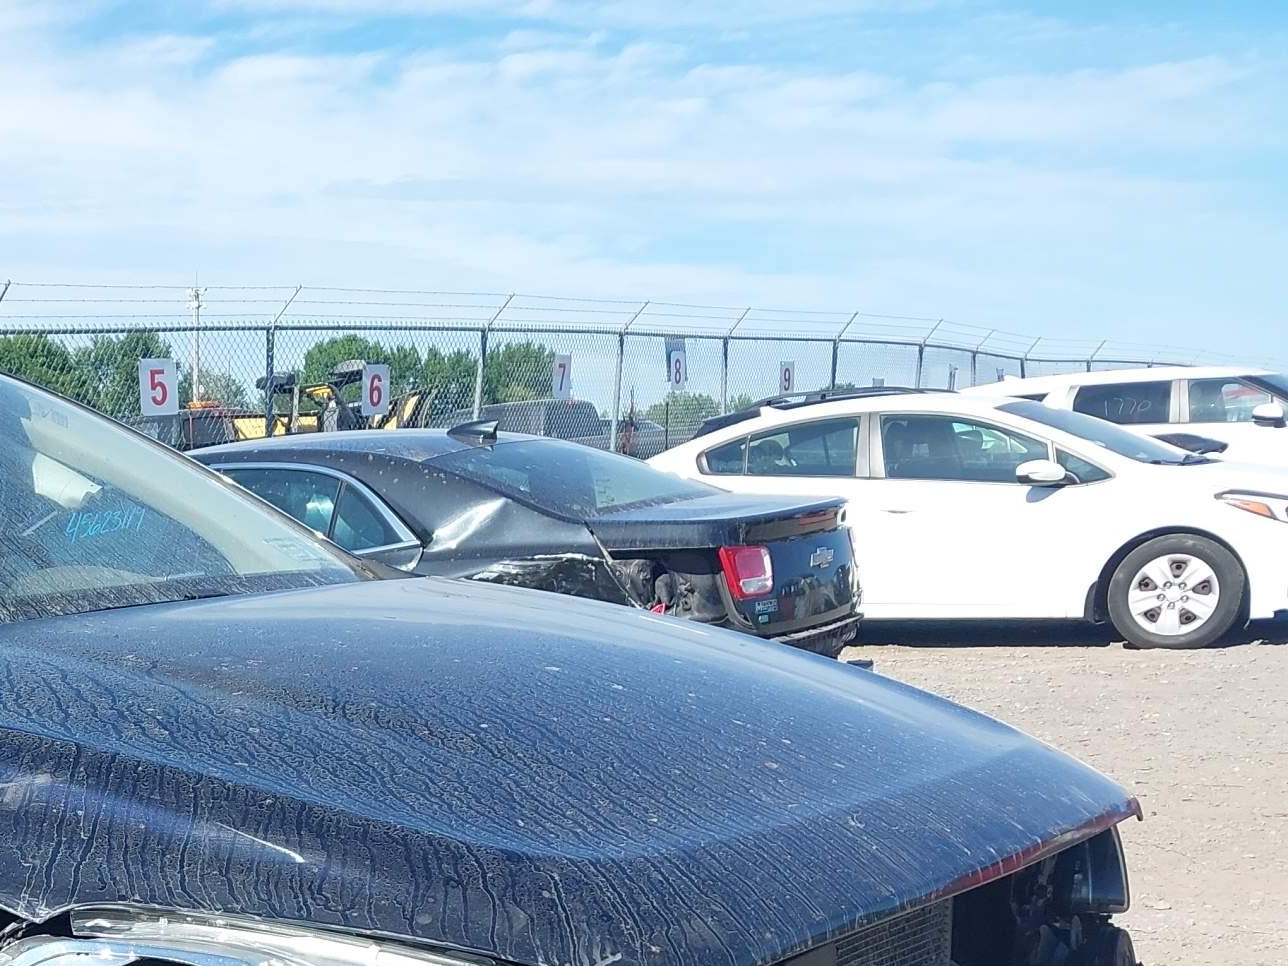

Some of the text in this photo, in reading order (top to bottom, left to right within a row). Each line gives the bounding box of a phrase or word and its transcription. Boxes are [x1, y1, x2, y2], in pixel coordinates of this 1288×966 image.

[558, 362, 566, 391] 7
[673, 357, 683, 385] 8
[783, 367, 791, 392] 9
[149, 368, 168, 406] 5
[369, 373, 383, 407] 6
